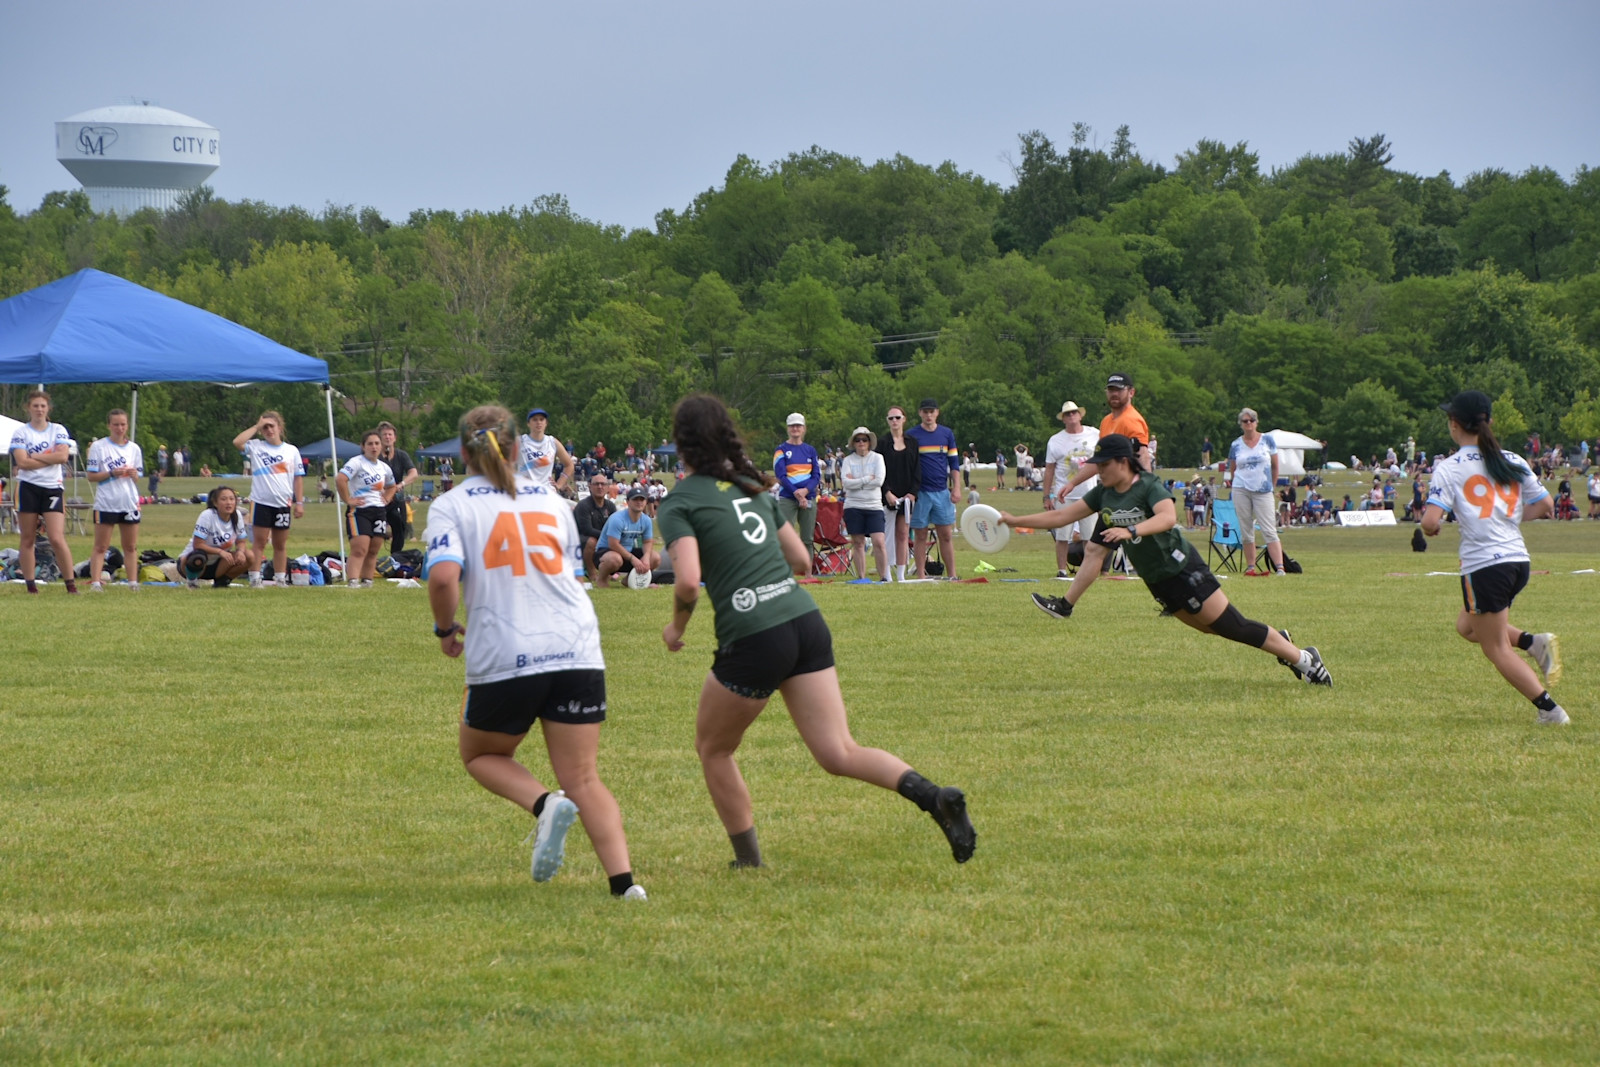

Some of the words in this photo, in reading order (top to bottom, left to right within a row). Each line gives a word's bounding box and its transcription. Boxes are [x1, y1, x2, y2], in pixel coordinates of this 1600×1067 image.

[173, 136, 204, 154] CITY
[209, 138, 217, 155] OF
[262, 455, 284, 466] EWO
[363, 473, 382, 485] EWO
[465, 485, 548, 497] KOWLSKI
[1463, 474, 1520, 519] 99
[49, 496, 59, 510] 7
[274, 513, 290, 527] 23
[732, 497, 767, 544] 5
[212, 532, 231, 545] EWO
[483, 511, 563, 576] 45
[533, 651, 576, 663] ULTIMATE
